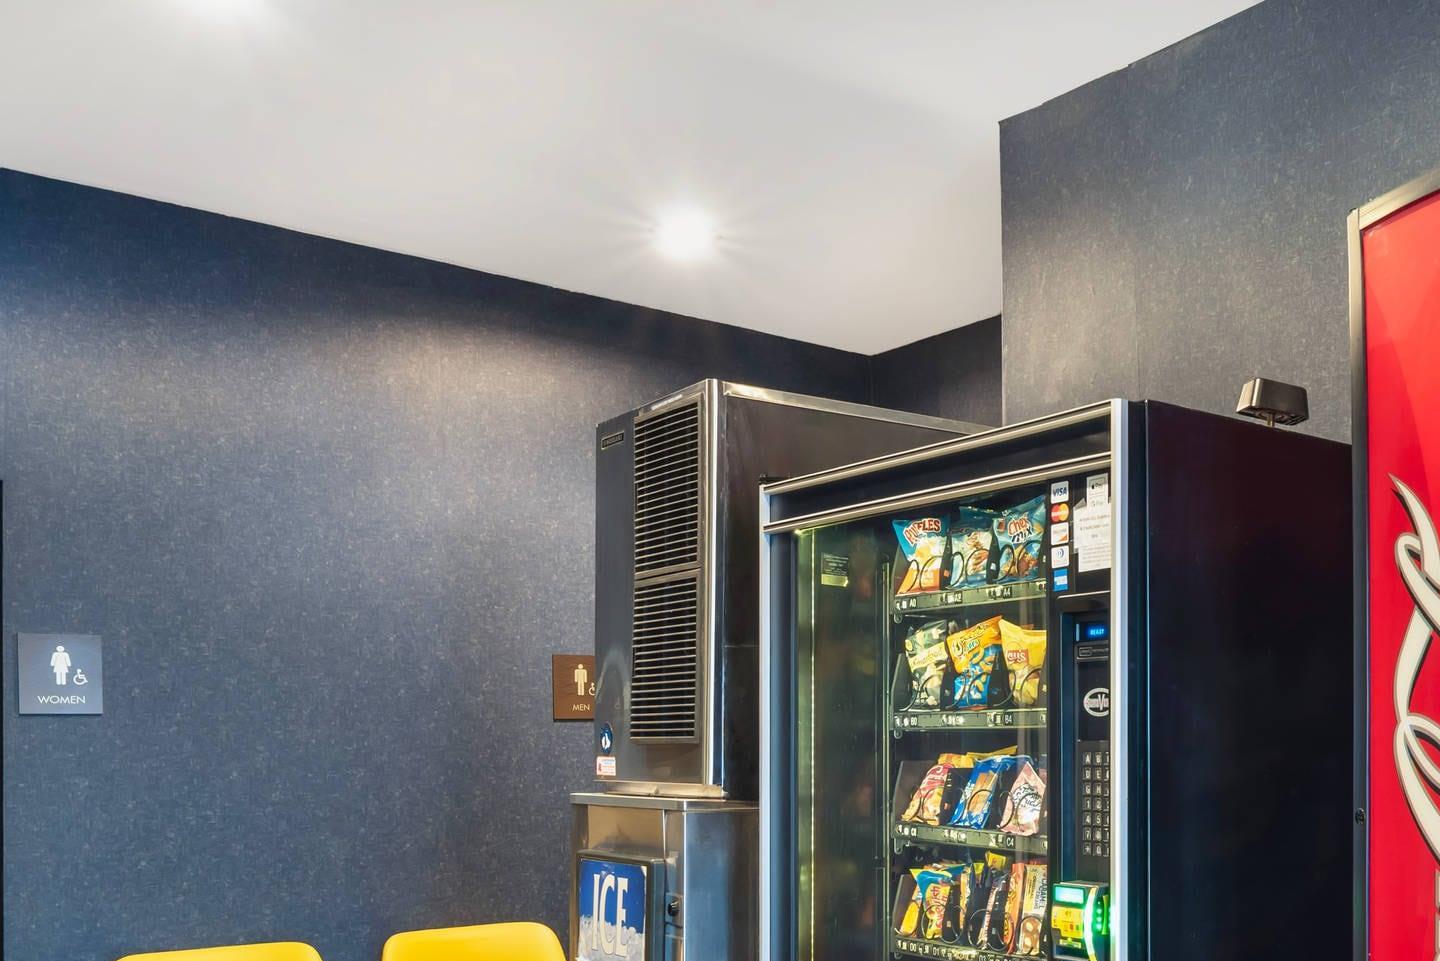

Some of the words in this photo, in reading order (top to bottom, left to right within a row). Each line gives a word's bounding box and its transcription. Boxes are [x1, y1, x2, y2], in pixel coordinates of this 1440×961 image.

[1053, 486, 1067, 497] VISA
[903, 517, 941, 546] RUFFLES
[1008, 513, 1031, 535] Chex
[37, 694, 87, 705] WOMEN
[572, 703, 591, 713] MEN
[591, 873, 630, 958] ICE
